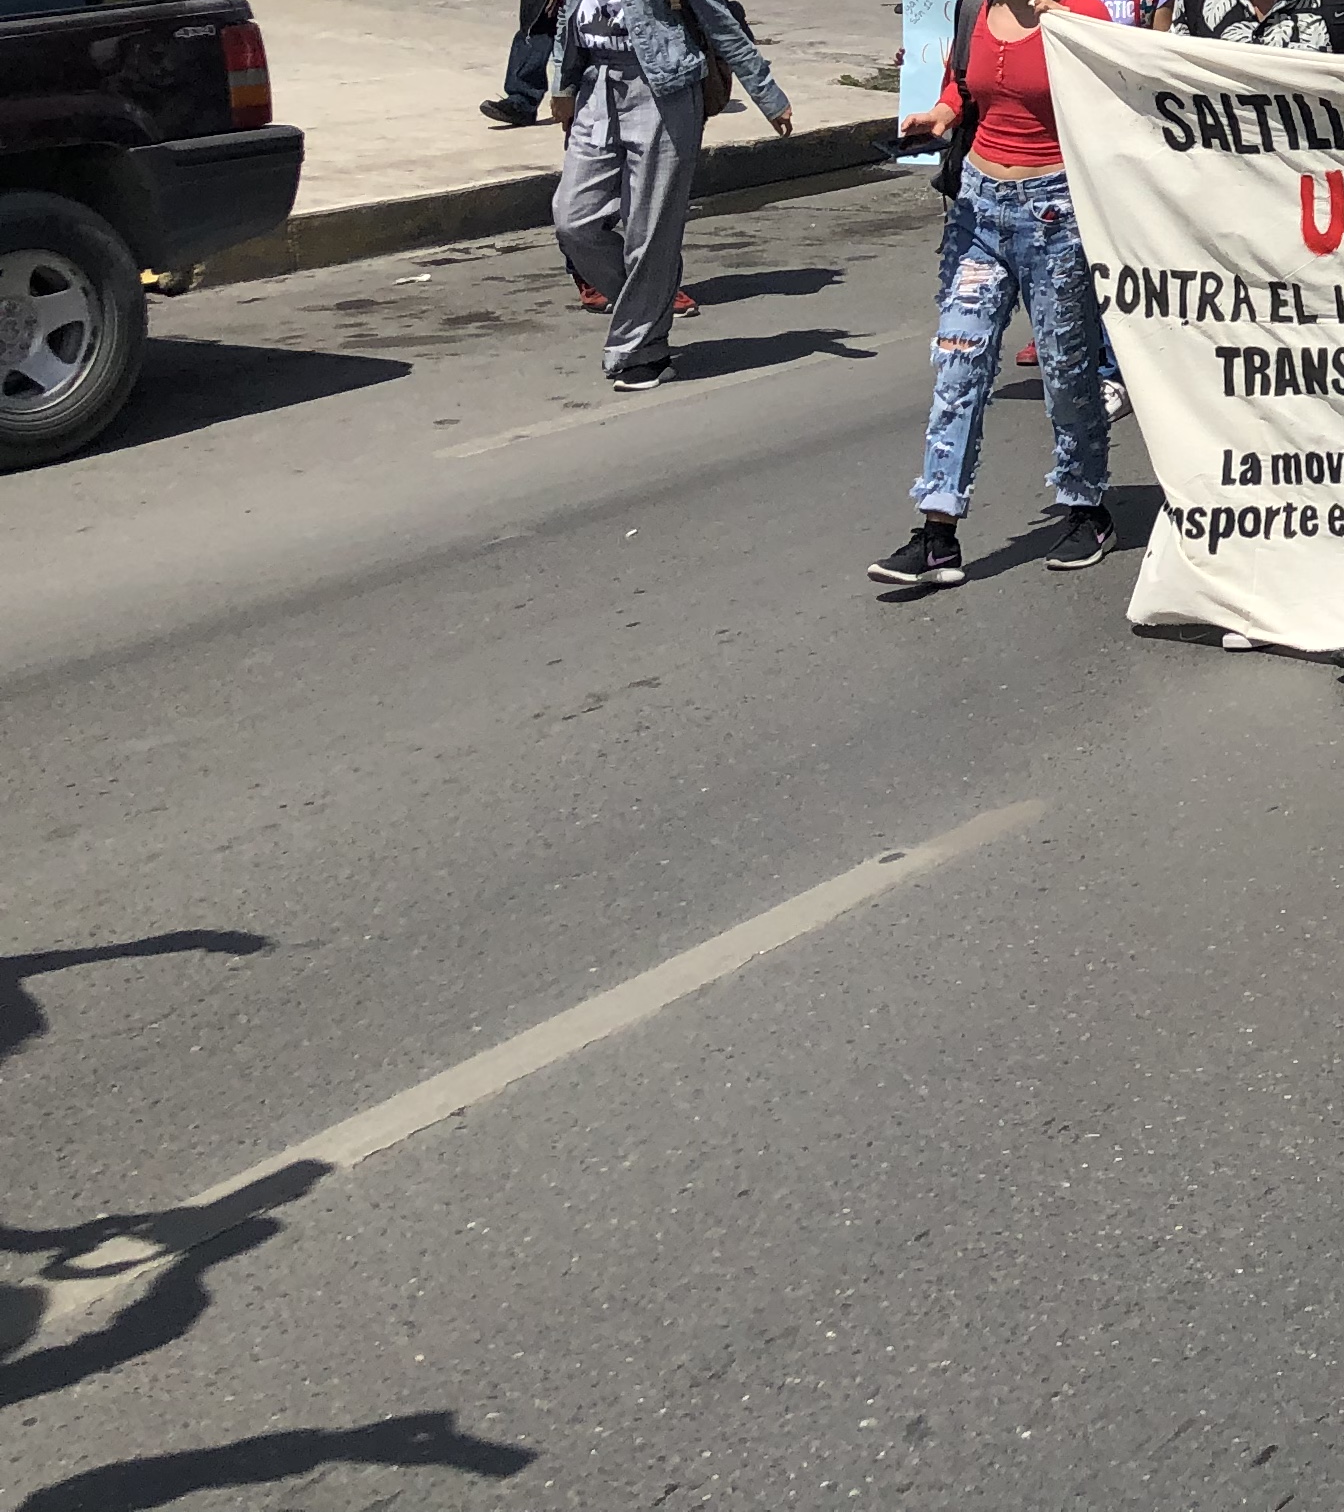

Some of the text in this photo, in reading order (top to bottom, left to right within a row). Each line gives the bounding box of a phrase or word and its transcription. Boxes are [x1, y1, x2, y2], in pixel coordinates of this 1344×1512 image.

[1090, 262, 1258, 323] CONTRA
[1267, 280, 1320, 325] EL
[1221, 446, 1263, 486] La
